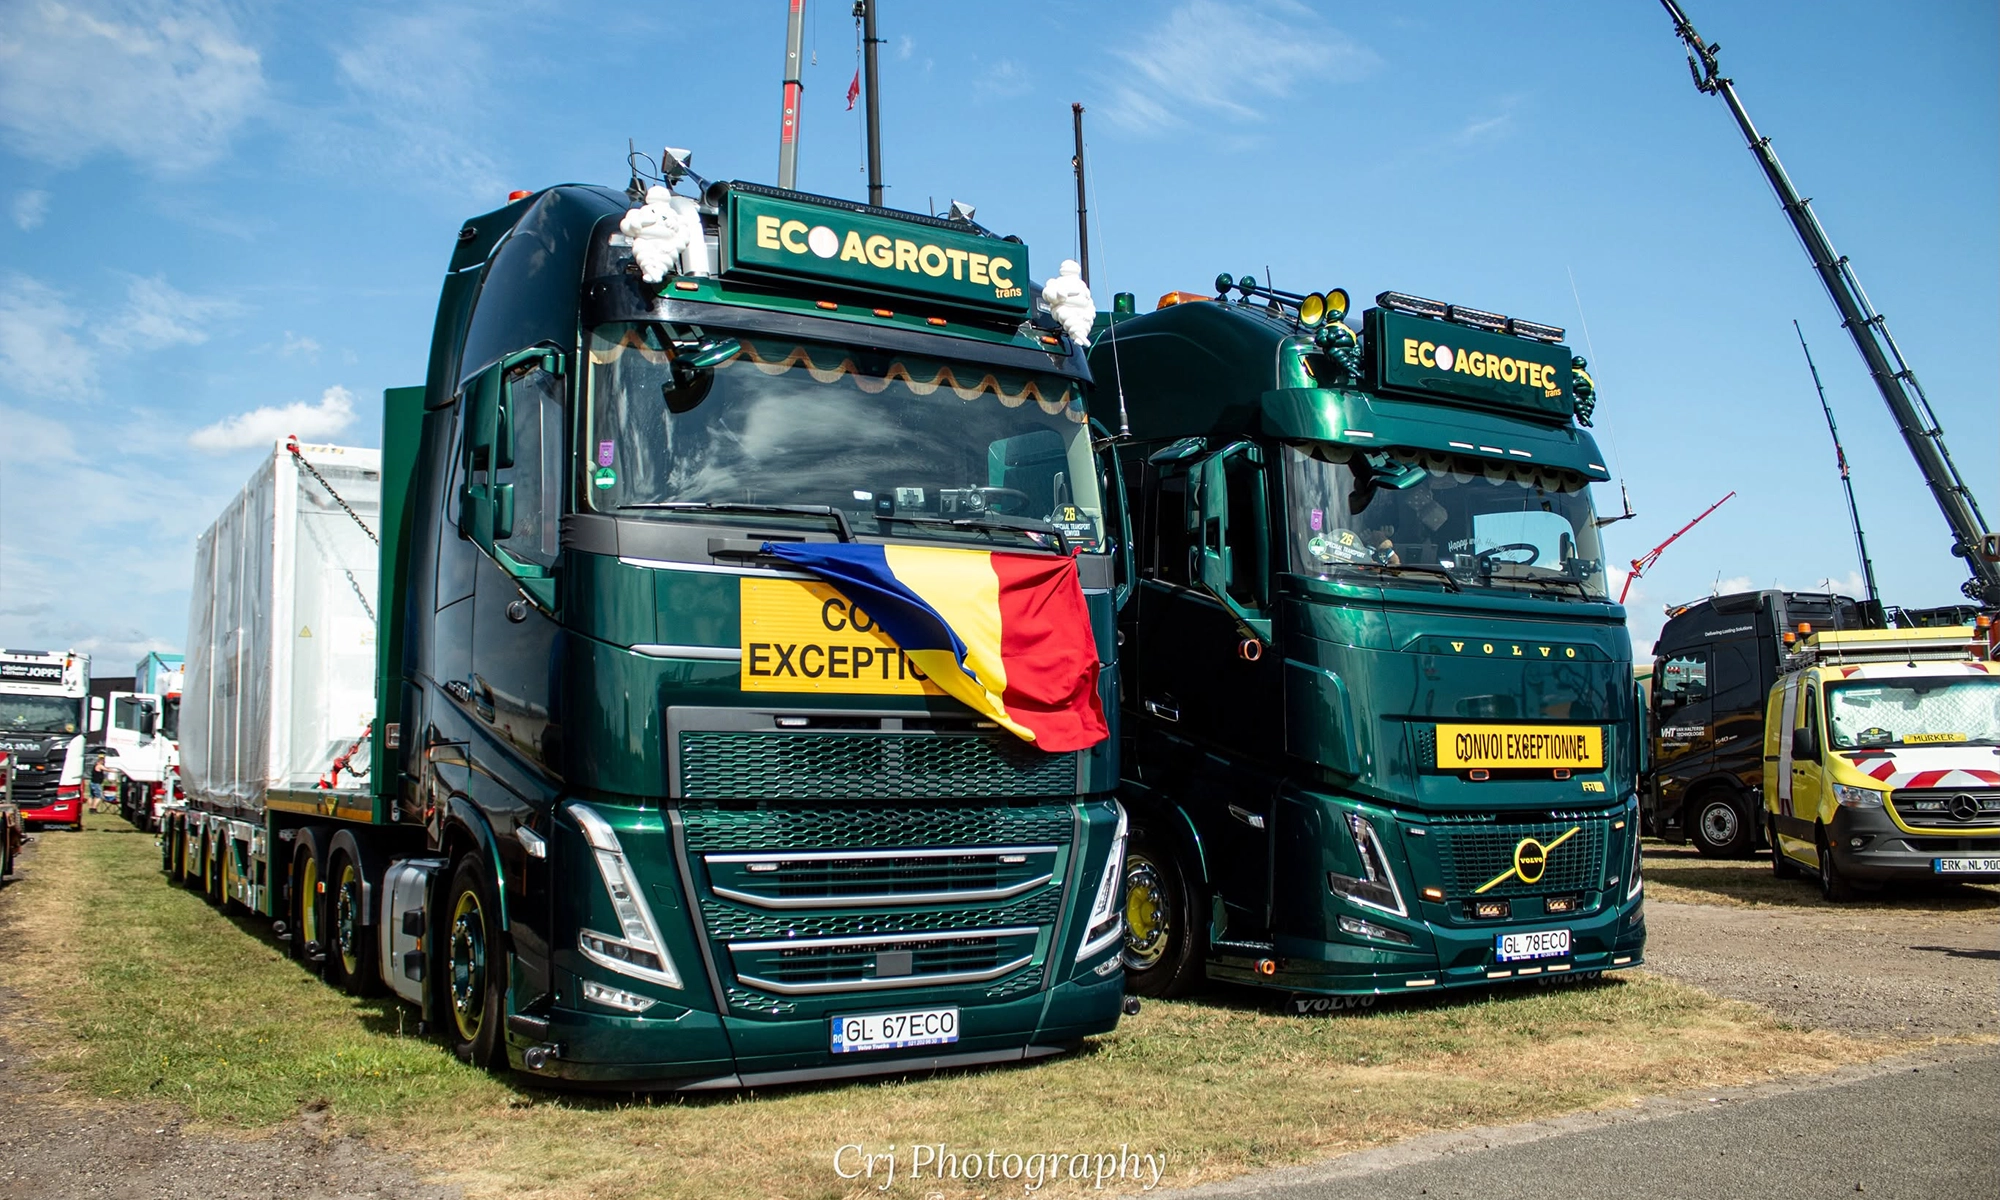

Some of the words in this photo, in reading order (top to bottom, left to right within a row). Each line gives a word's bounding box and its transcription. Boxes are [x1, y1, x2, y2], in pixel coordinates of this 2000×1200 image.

[757, 214, 1014, 289] ECOAGROTEC
[995, 286, 1022, 299] trans
[1404, 338, 1556, 390] ECOAGROTEC
[1545, 387, 1562, 398] trans
[1064, 507, 1075, 521] 26
[1340, 532, 1354, 546] 26
[1451, 641, 1576, 658] VOLVO
[27, 668, 61, 678] JOPPE
[1661, 727, 1676, 737] VHT
[1455, 733, 1503, 760] CONVOI
[1507, 733, 1590, 761] EXCEPTIONNEL
[1942, 860, 1961, 870] ERK
[1968, 860, 1981, 870] NL
[1504, 936, 1520, 954] GL
[1525, 931, 1567, 953] 78ECO
[1295, 996, 1375, 1014] VOLVO
[846, 1019, 873, 1042] GL
[882, 1011, 954, 1039] 67ECO
[832, 1034, 843, 1044] RO
